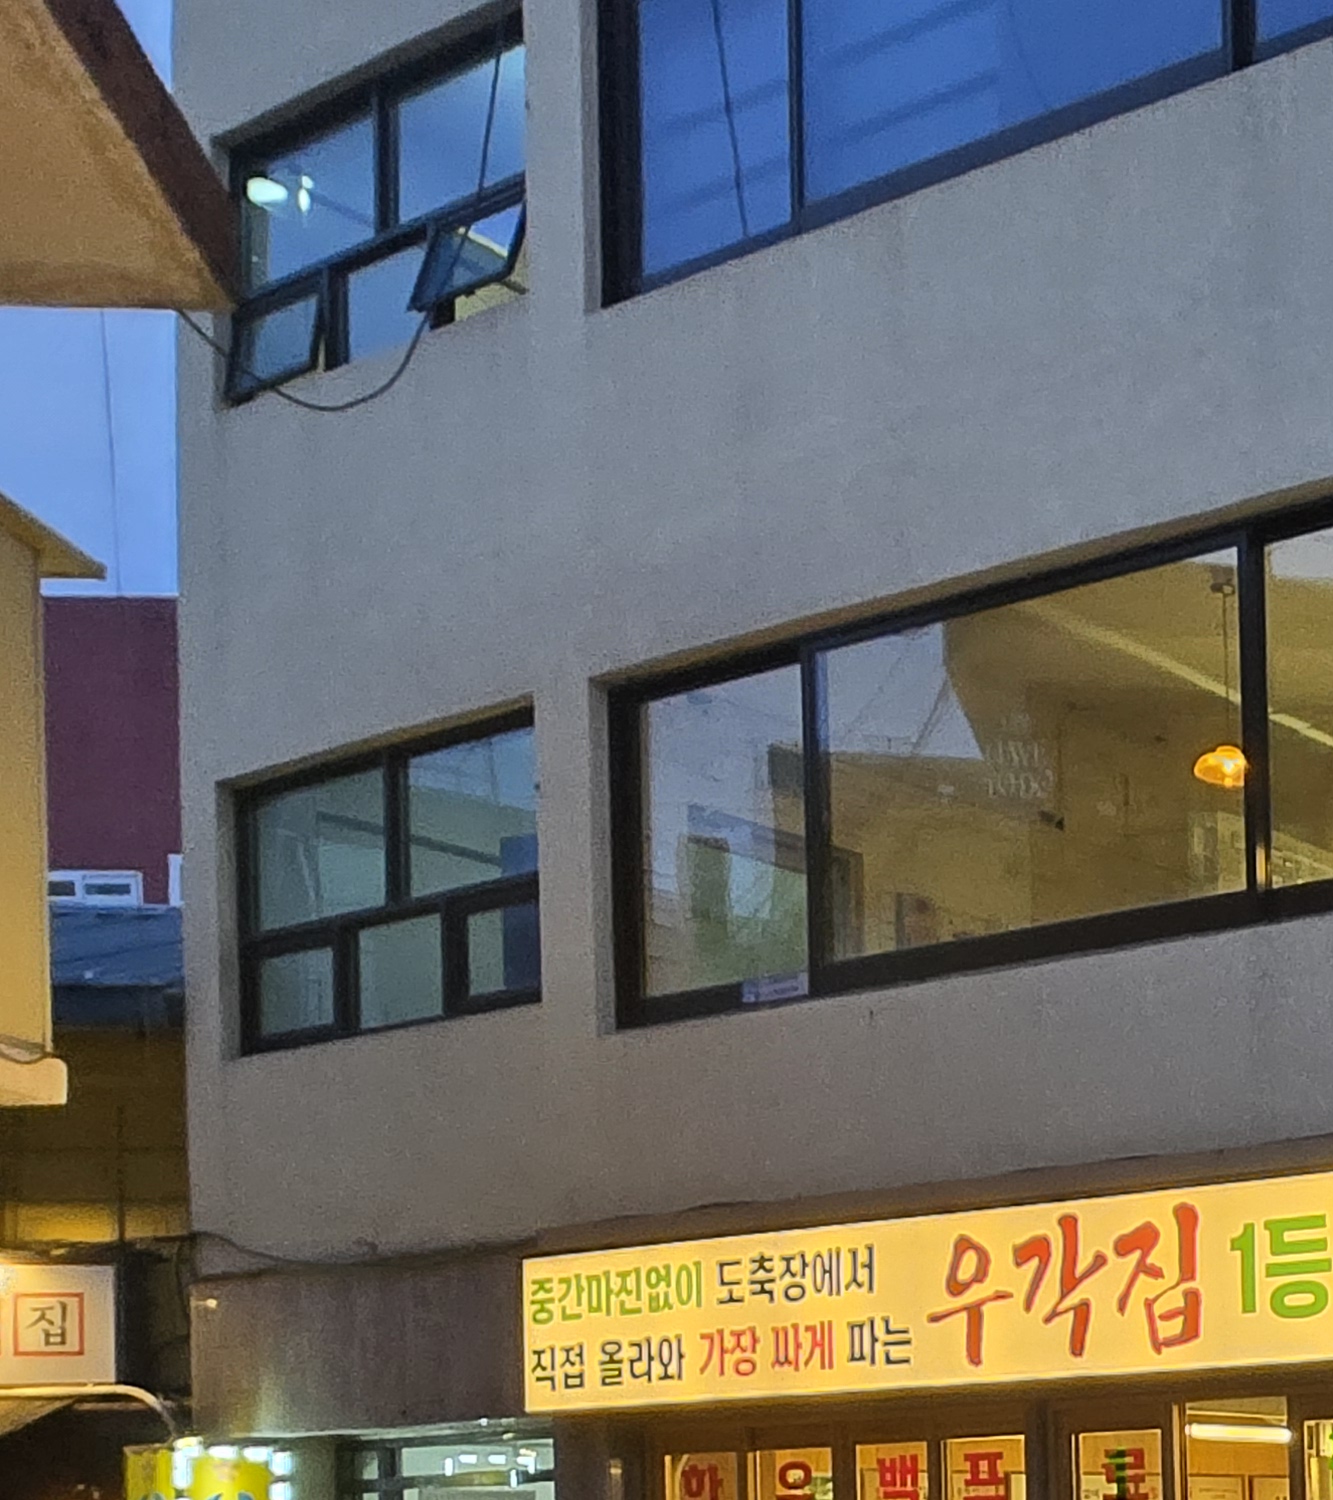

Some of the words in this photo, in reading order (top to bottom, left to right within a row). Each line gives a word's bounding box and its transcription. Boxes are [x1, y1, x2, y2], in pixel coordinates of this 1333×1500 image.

[25, 1300, 70, 1349] 집
[530, 1260, 702, 1326] 중간마진없이
[715, 1243, 876, 1306] 도축장에서
[925, 1201, 1203, 1368] 우각집
[530, 1342, 586, 1392] 직접
[599, 1333, 685, 1387] 올라와
[699, 1326, 760, 1378] 가장
[770, 1319, 836, 1373] 싸게
[846, 1315, 914, 1368] 파는
